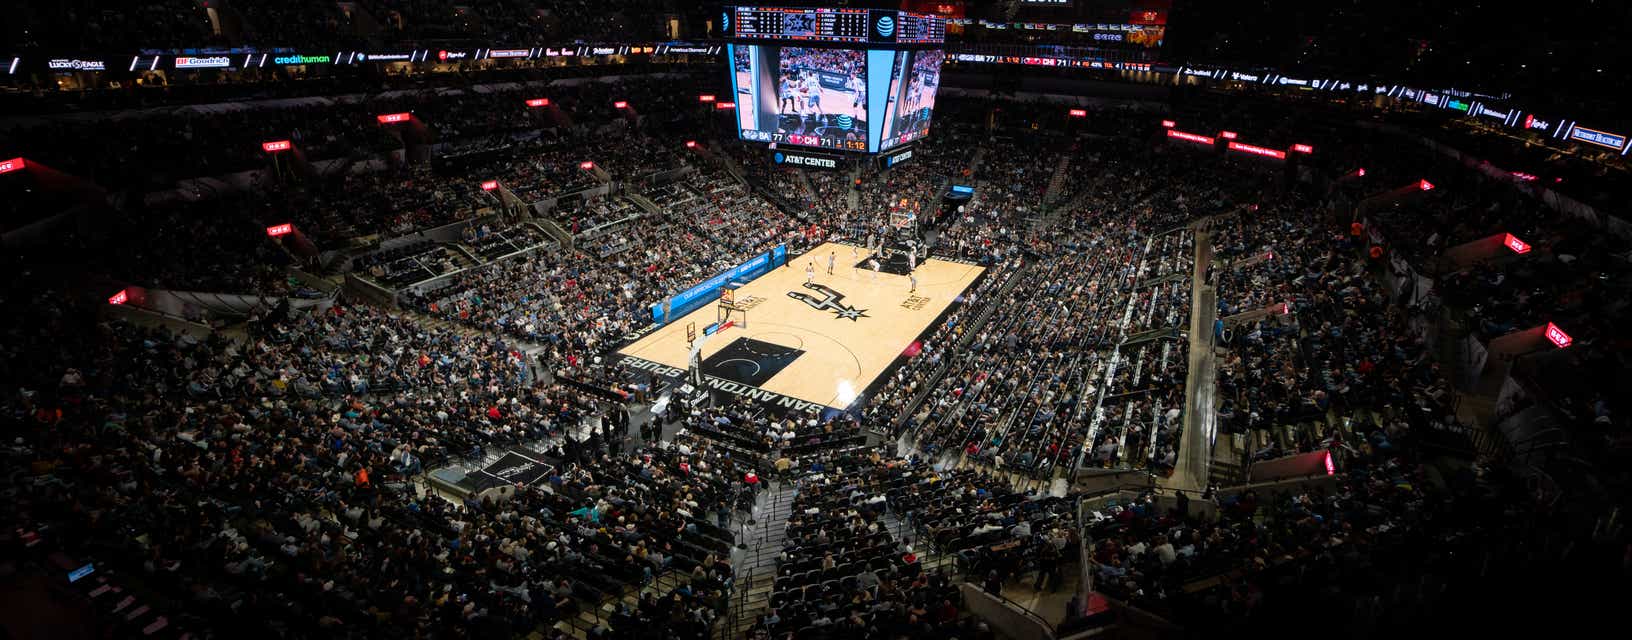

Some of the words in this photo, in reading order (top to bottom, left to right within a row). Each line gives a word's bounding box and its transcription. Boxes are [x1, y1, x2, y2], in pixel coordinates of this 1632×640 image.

[275, 55, 330, 65] credithuman
[804, 136, 818, 145] CHI
[821, 138, 831, 146] 71
[847, 140, 865, 150] 1:12
[785, 155, 805, 165] AT&T
[805, 157, 836, 168] CENTER
[623, 356, 683, 378] SPURS
[774, 395, 825, 415] SAN
